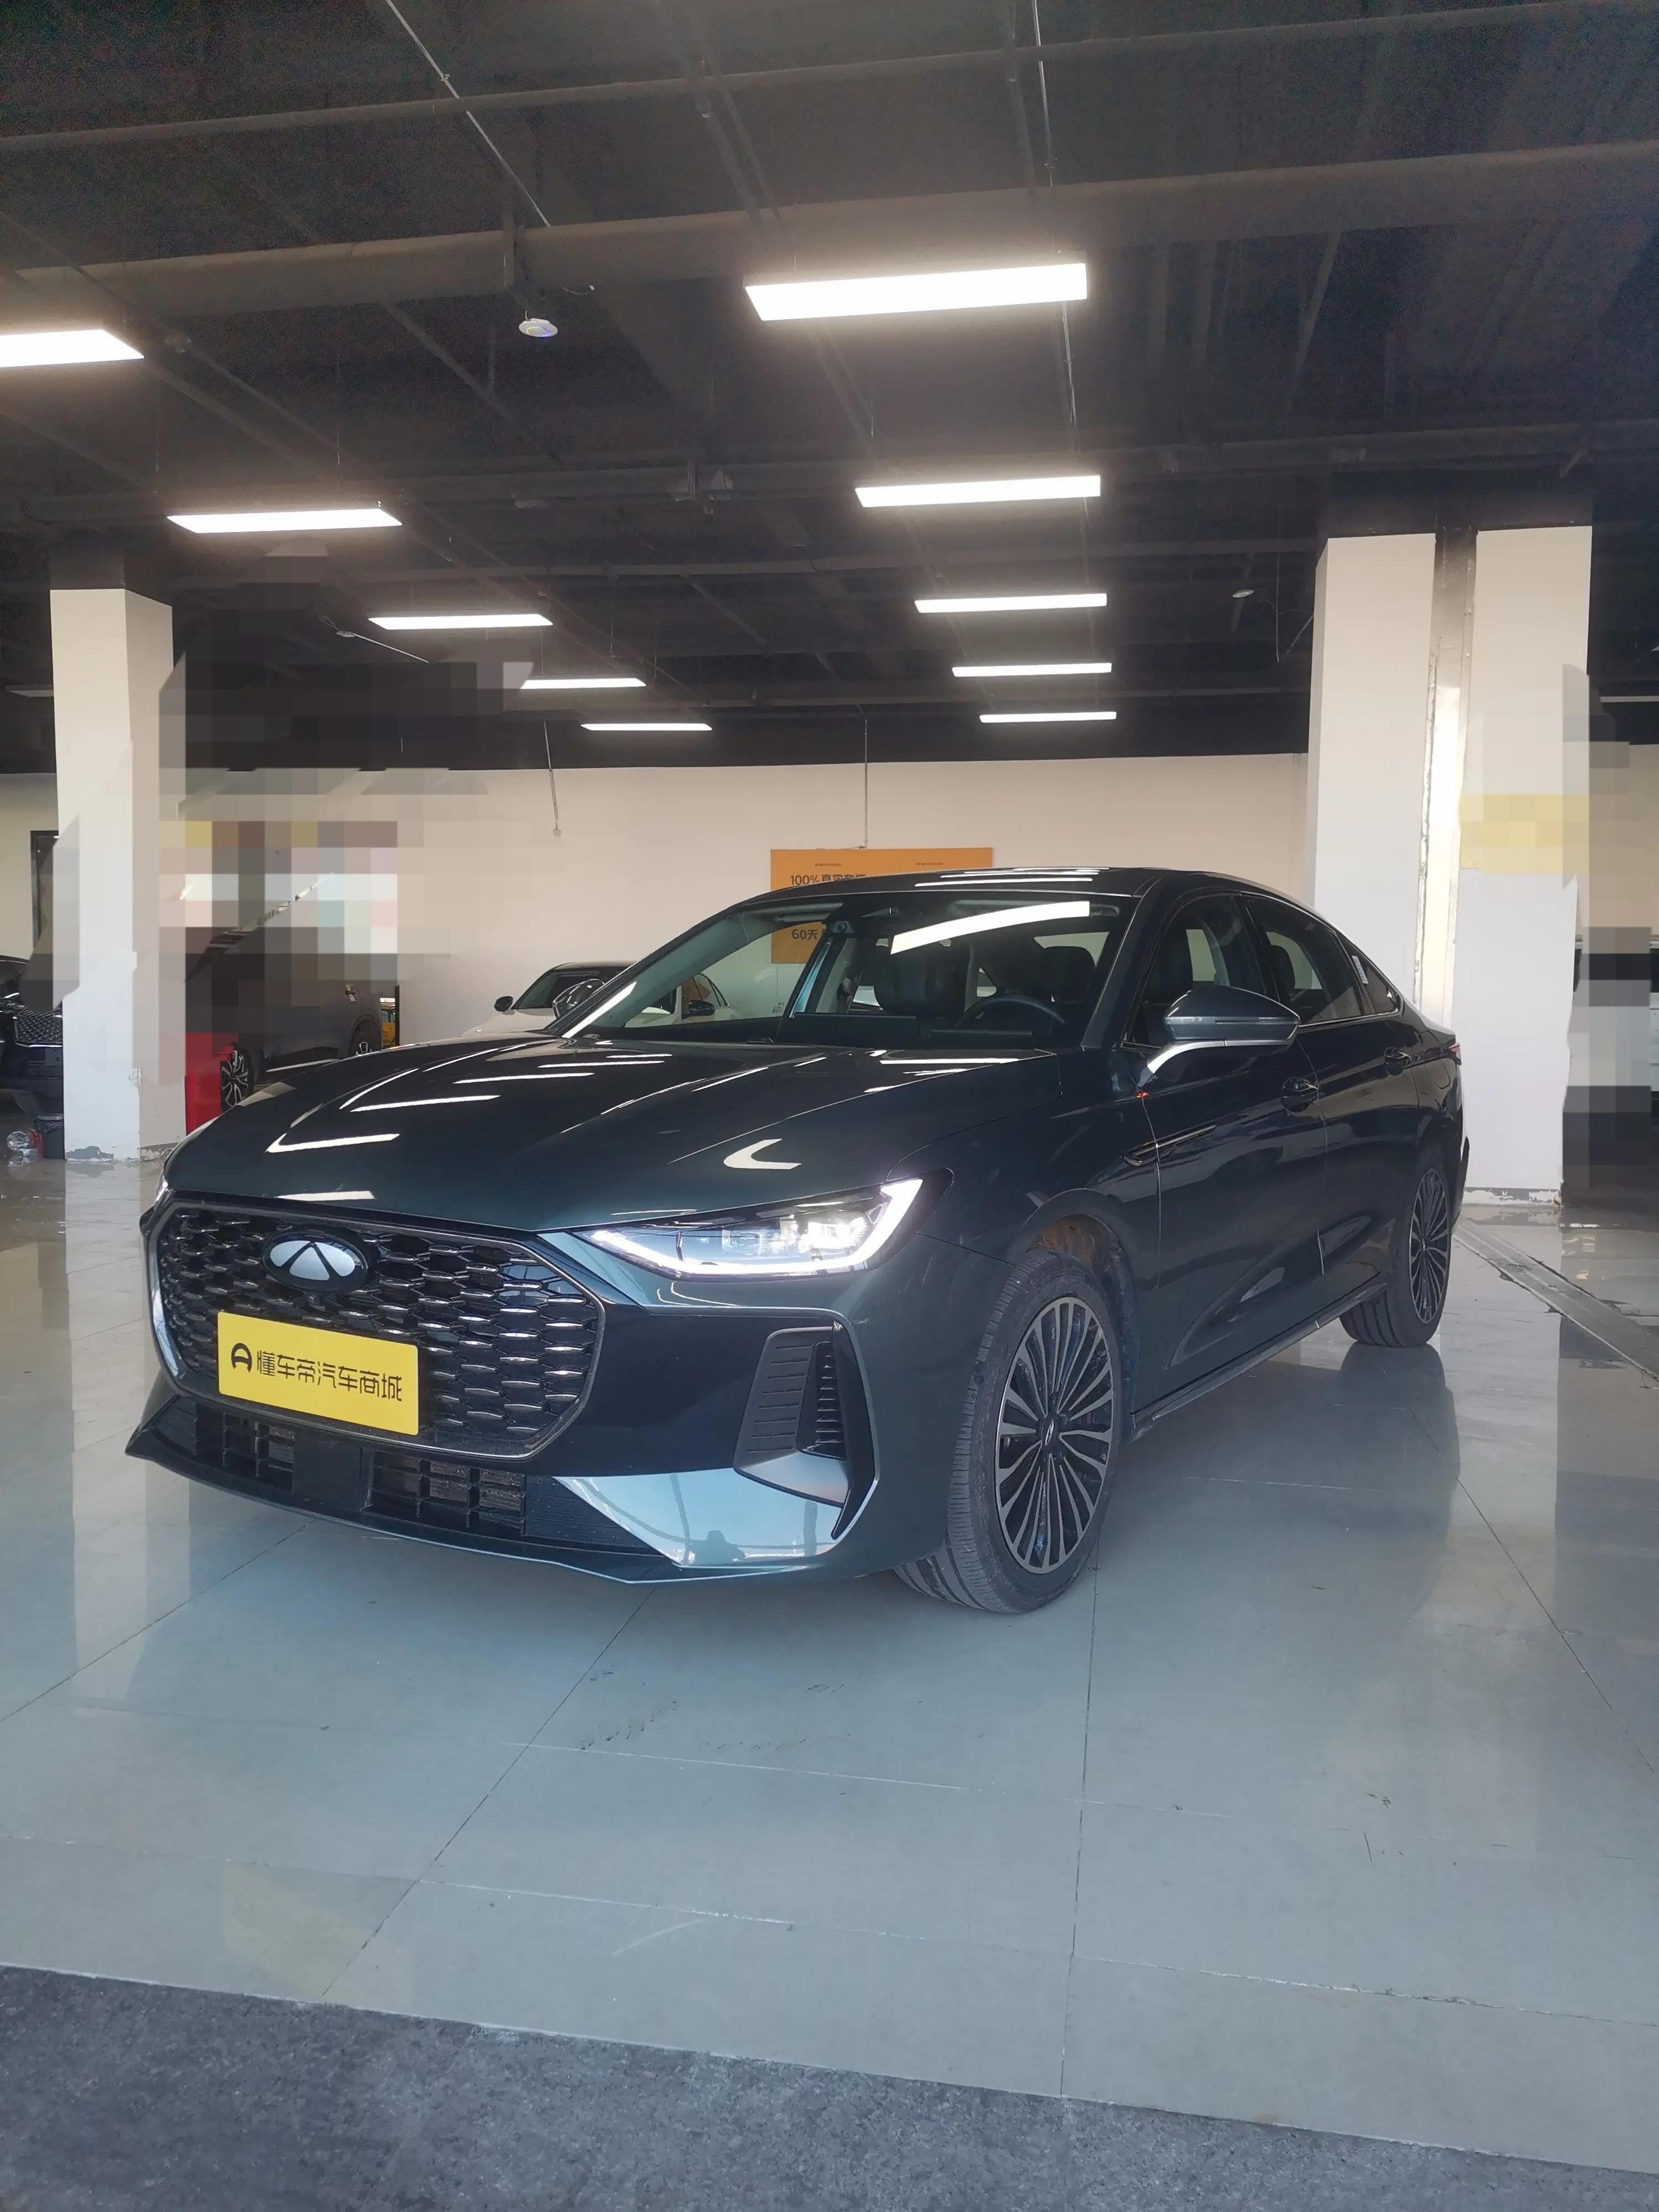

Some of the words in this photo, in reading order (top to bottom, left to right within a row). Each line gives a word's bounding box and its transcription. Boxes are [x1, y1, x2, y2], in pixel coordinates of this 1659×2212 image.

[256, 1350, 403, 1402] 懂车帝汽车商城
